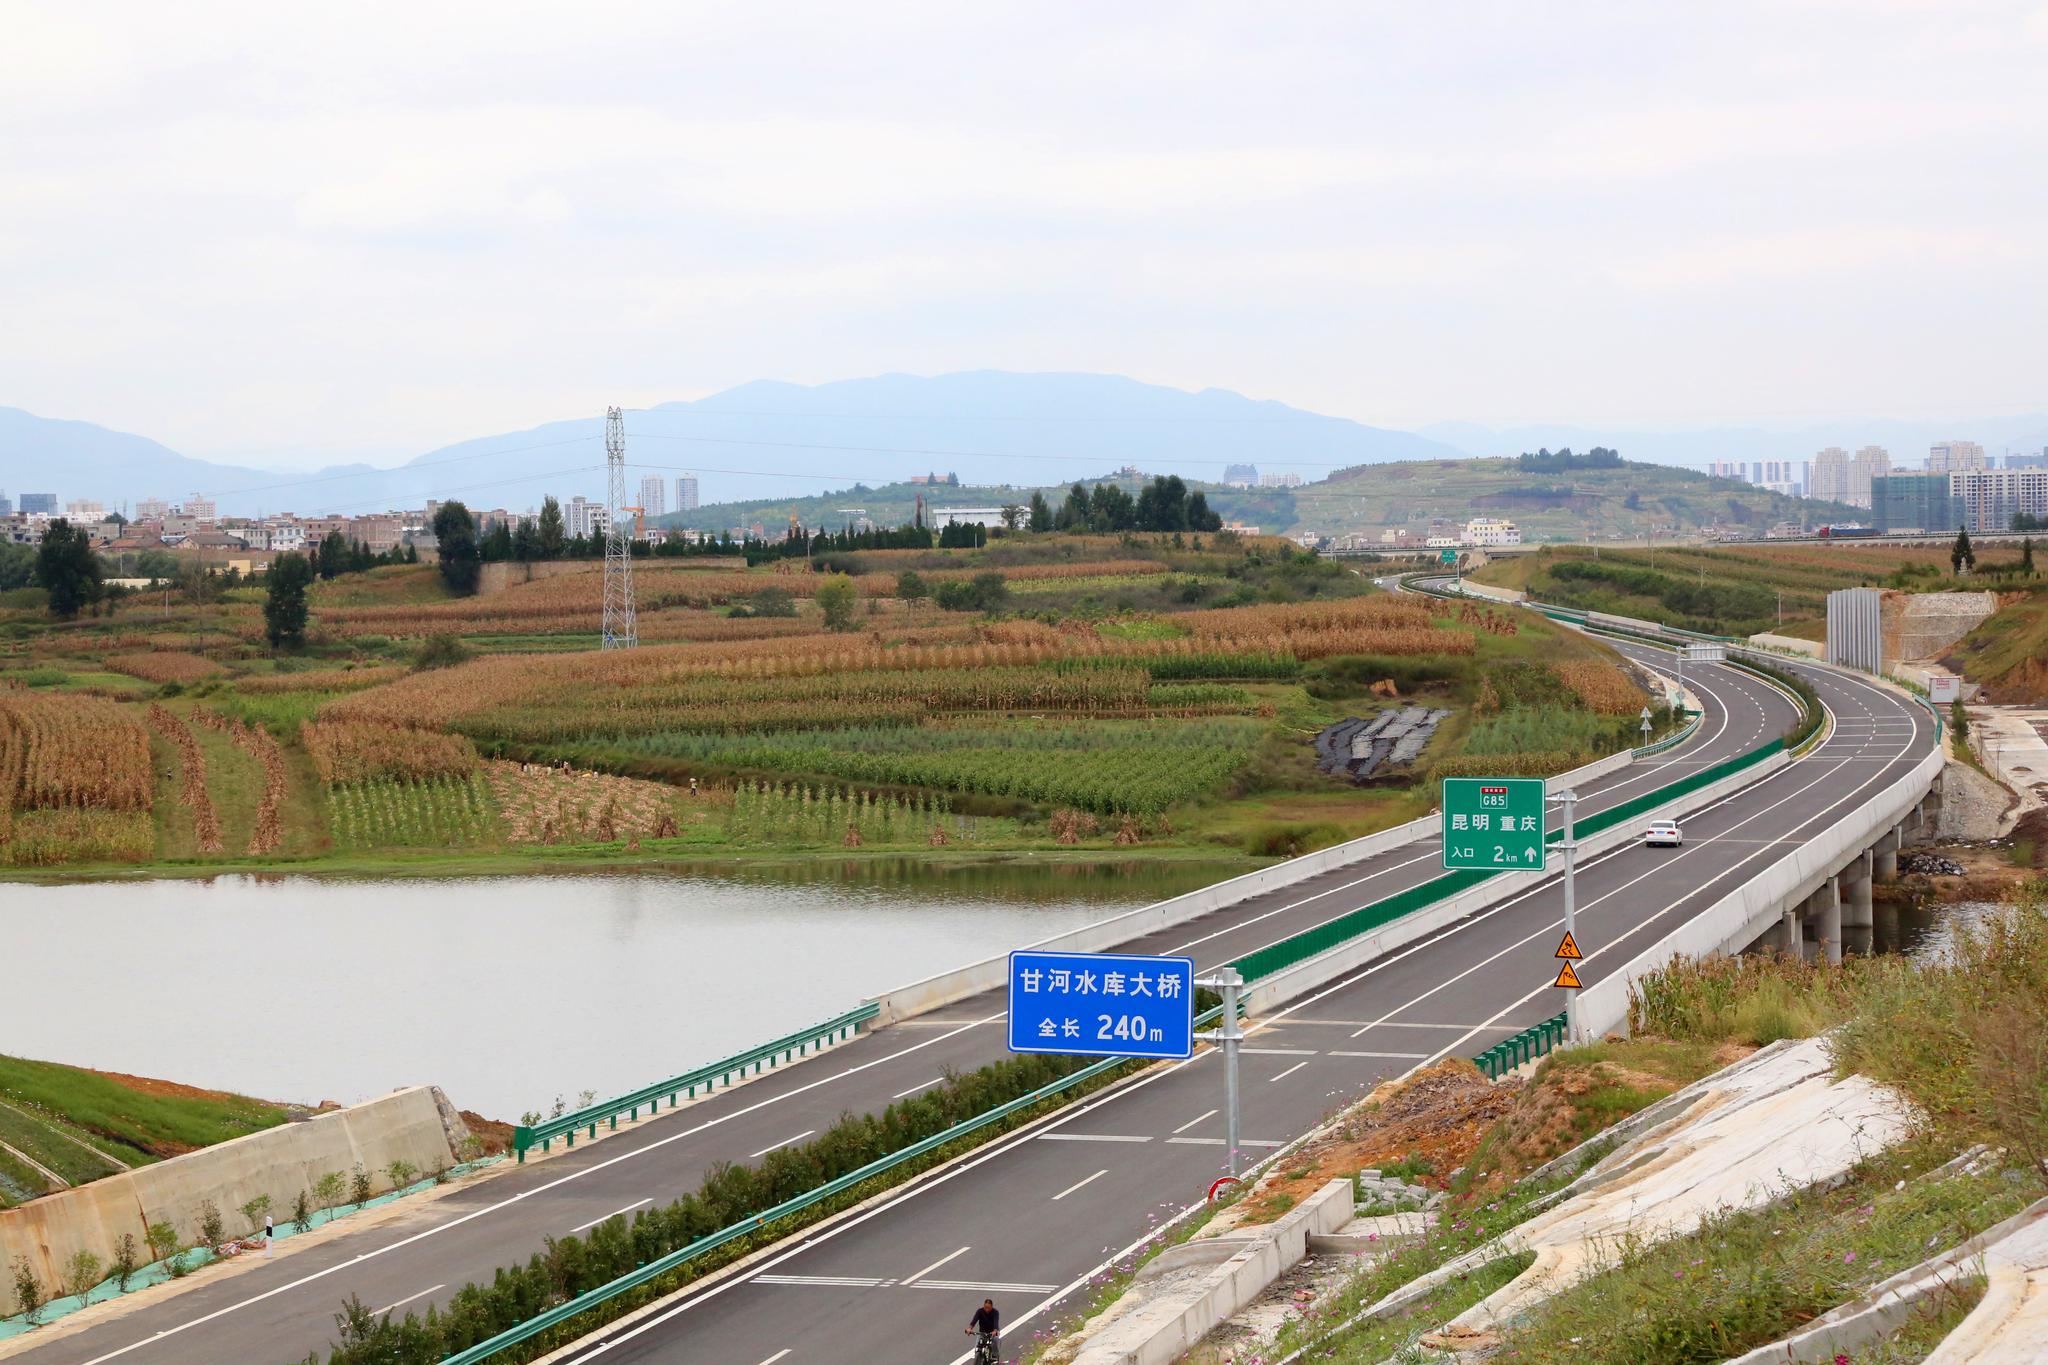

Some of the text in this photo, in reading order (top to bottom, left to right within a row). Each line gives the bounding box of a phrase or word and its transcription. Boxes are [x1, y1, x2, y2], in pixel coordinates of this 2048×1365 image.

[1483, 795, 1505, 806] G85
[1451, 813, 1537, 831] 昆明 重庆
[1451, 846, 1474, 858] 入口
[1020, 968, 1182, 999] 甘河水库大桥
[1038, 1017, 1080, 1038] 全长
